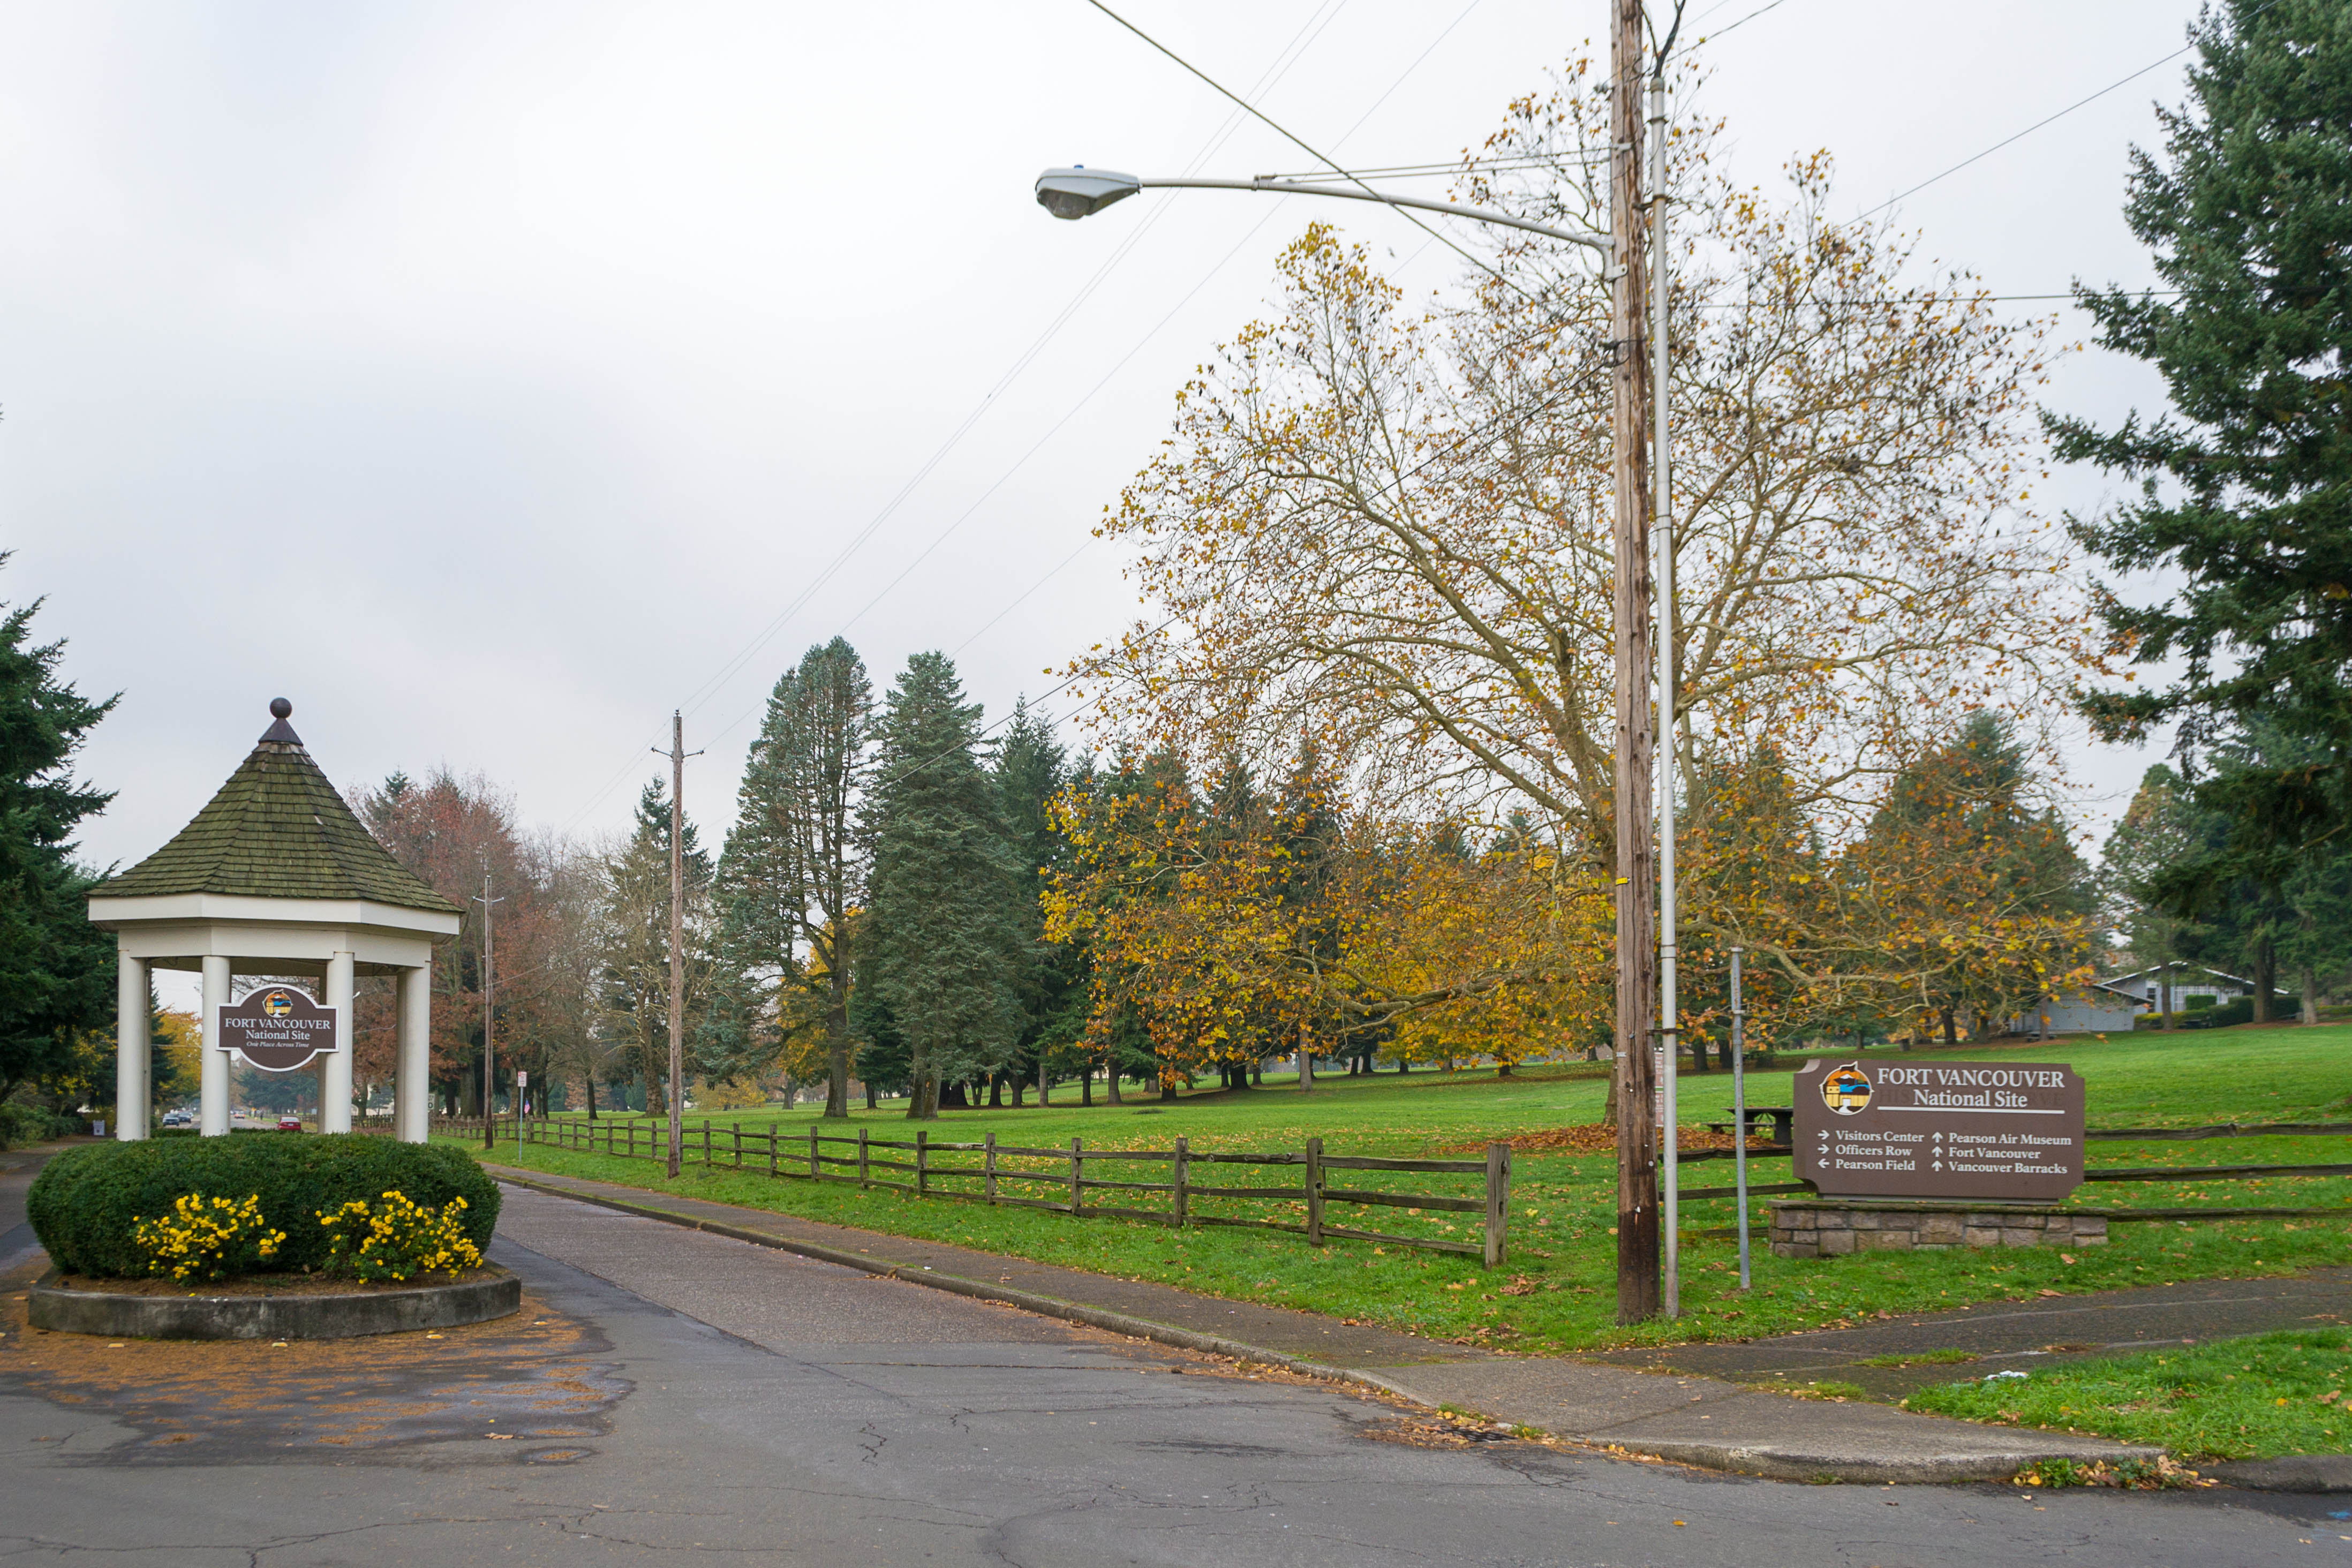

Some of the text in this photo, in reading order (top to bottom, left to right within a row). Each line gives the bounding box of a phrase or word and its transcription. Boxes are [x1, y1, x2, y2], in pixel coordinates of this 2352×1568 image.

[225, 1018, 330, 1029] FORT VANCOUVER
[246, 1030, 310, 1039] National Site
[1878, 1068, 2065, 1088] FORT VANCOUVER
[1913, 1089, 1991, 1106] National
[1994, 1090, 2029, 1107] Site
[1836, 1130, 1925, 1142] Visitors Center
[1949, 1133, 2072, 1145] Pearson Air Museum
[1836, 1144, 1912, 1156] Officers Row
[1949, 1147, 2041, 1158] Fort Vancouver
[1836, 1159, 1915, 1170] Pearson Field
[1949, 1162, 2067, 1173] Vancouver Barracks
